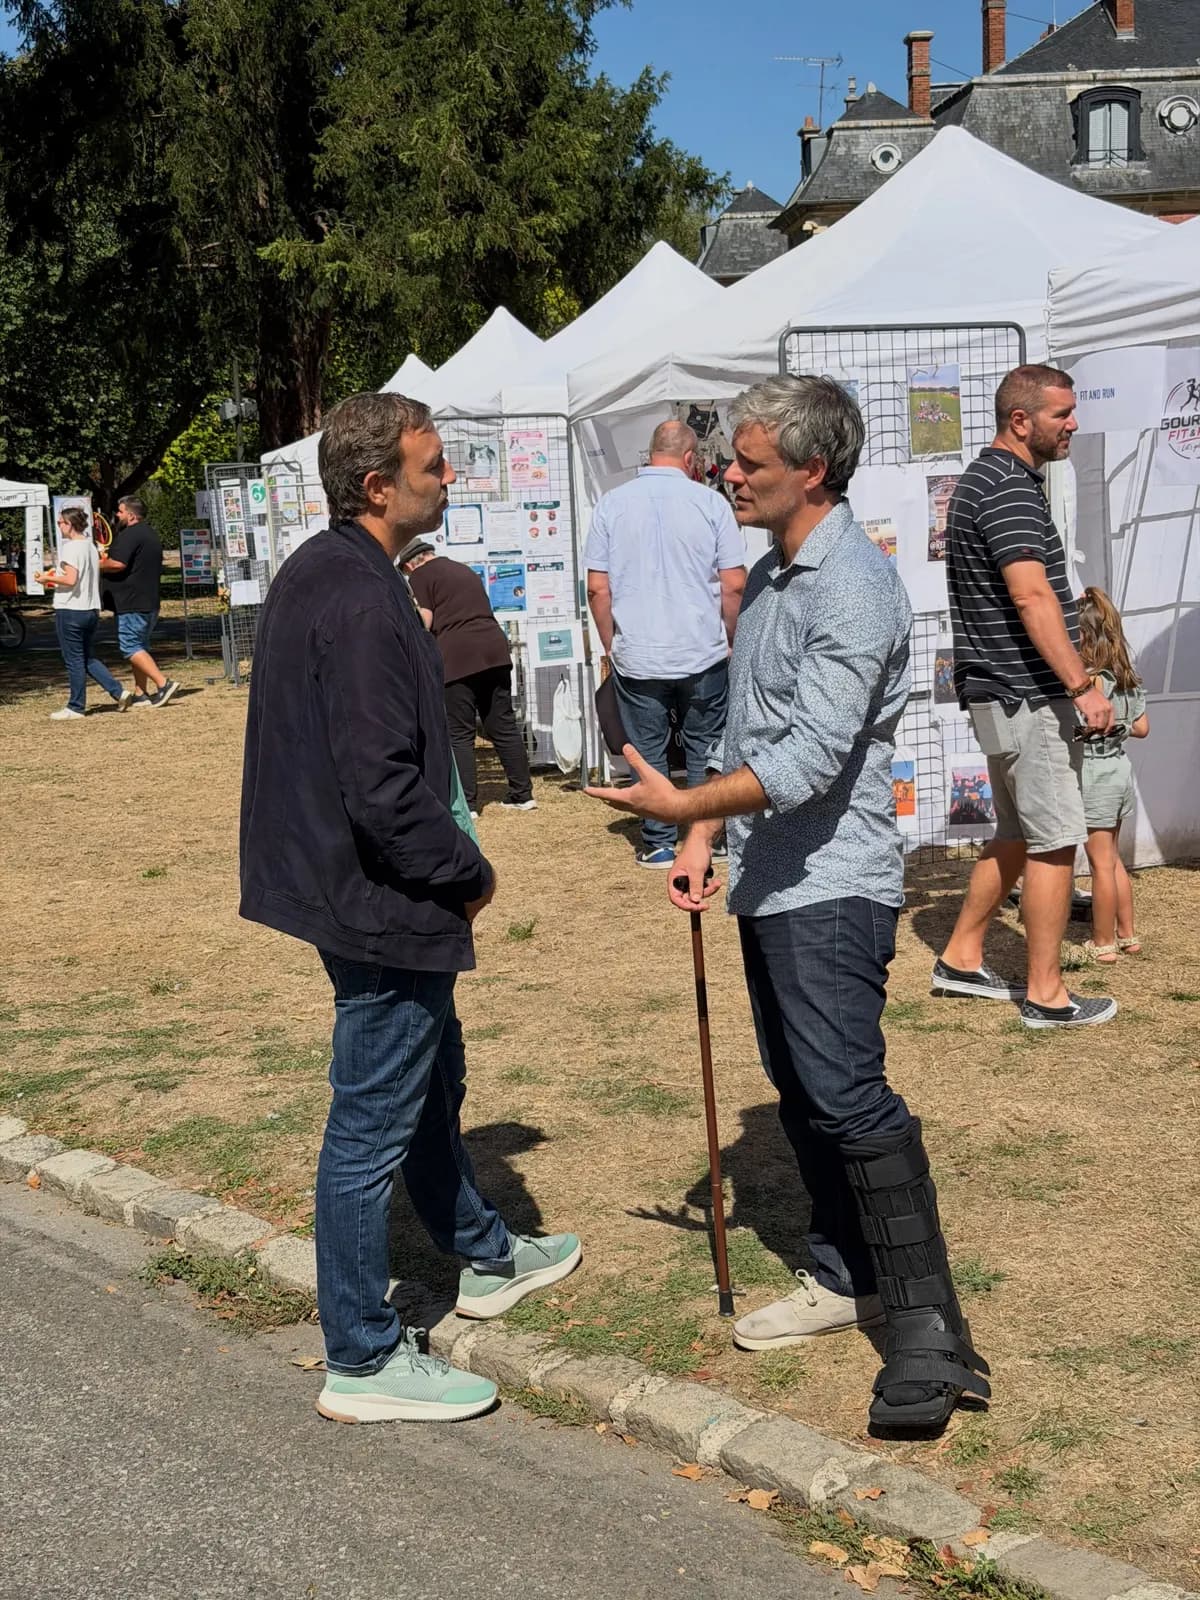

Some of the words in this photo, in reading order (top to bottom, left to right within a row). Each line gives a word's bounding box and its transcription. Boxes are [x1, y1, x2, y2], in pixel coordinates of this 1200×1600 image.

[1080, 390, 1088, 400] FIT
[1089, 388, 1100, 400] AND
[1102, 387, 1115, 399] RUN
[1167, 428, 1188, 441] FIT
[1189, 429, 1195, 438] &
